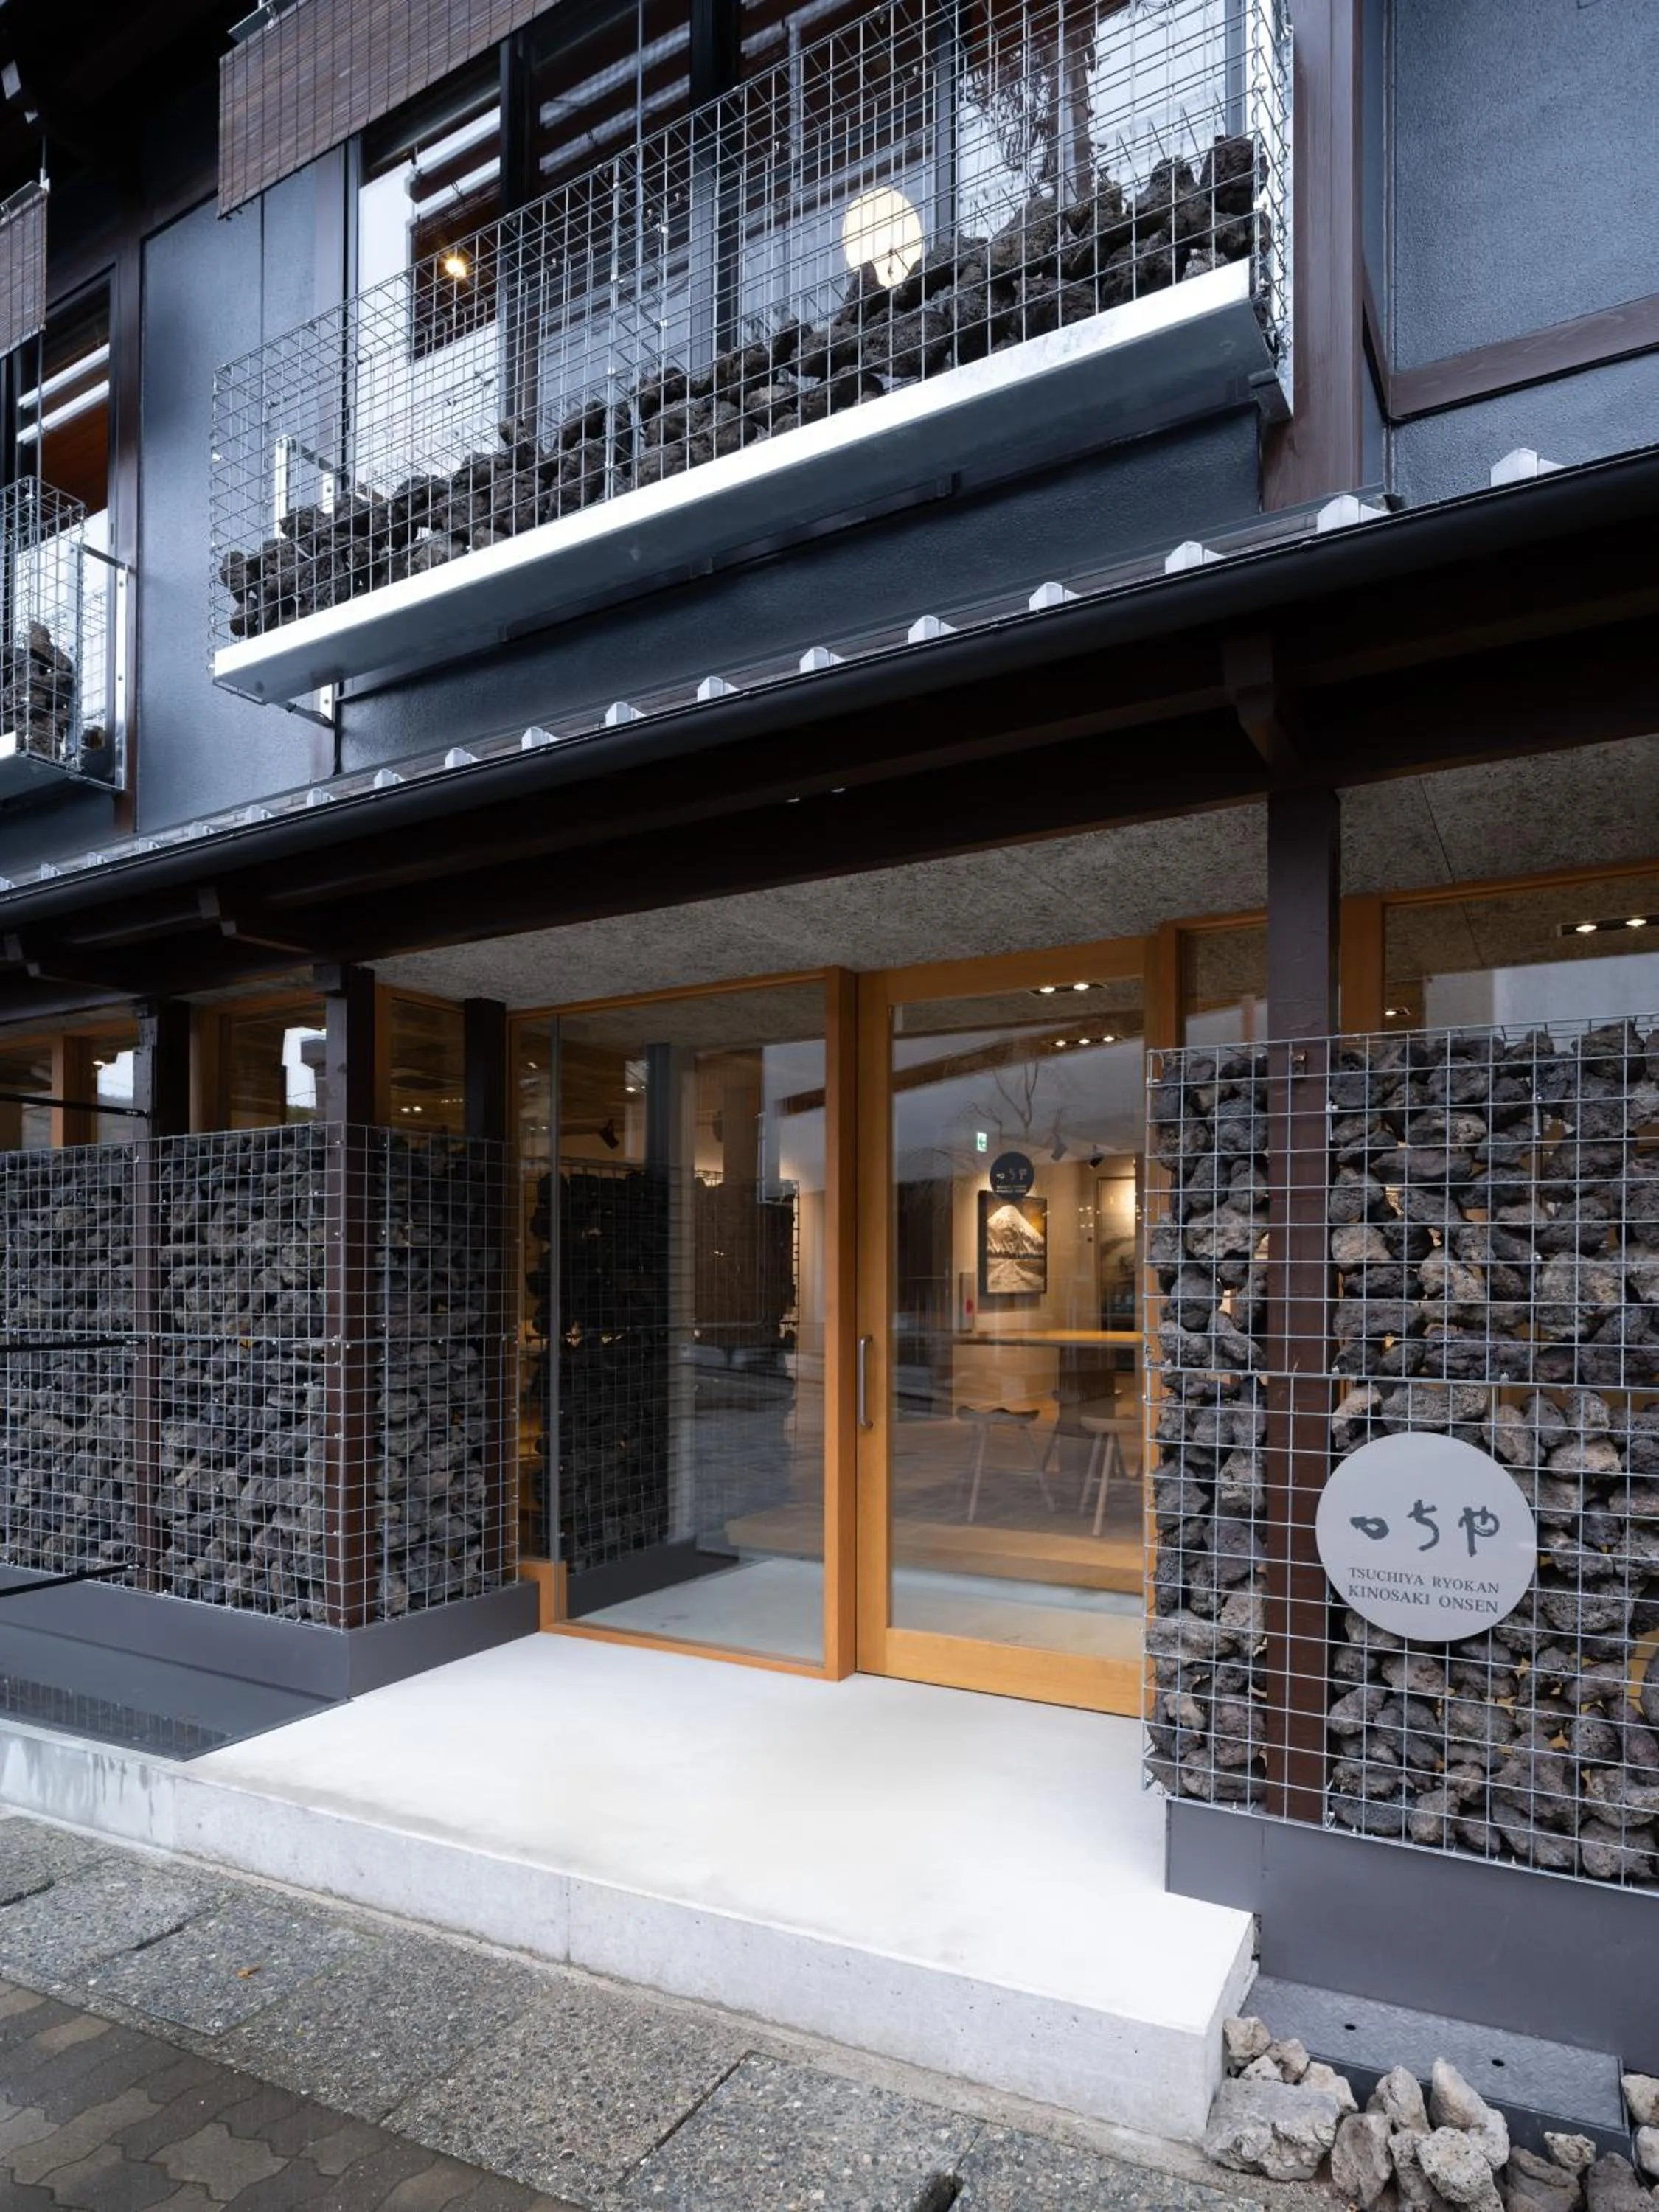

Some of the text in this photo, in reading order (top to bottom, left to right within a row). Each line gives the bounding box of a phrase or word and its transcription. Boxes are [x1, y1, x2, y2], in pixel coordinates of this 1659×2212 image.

[1349, 1567, 1499, 1593] TSUCHIYA RYOKAN
[1349, 1585, 1498, 1613] KINOSAKI ONSEN
